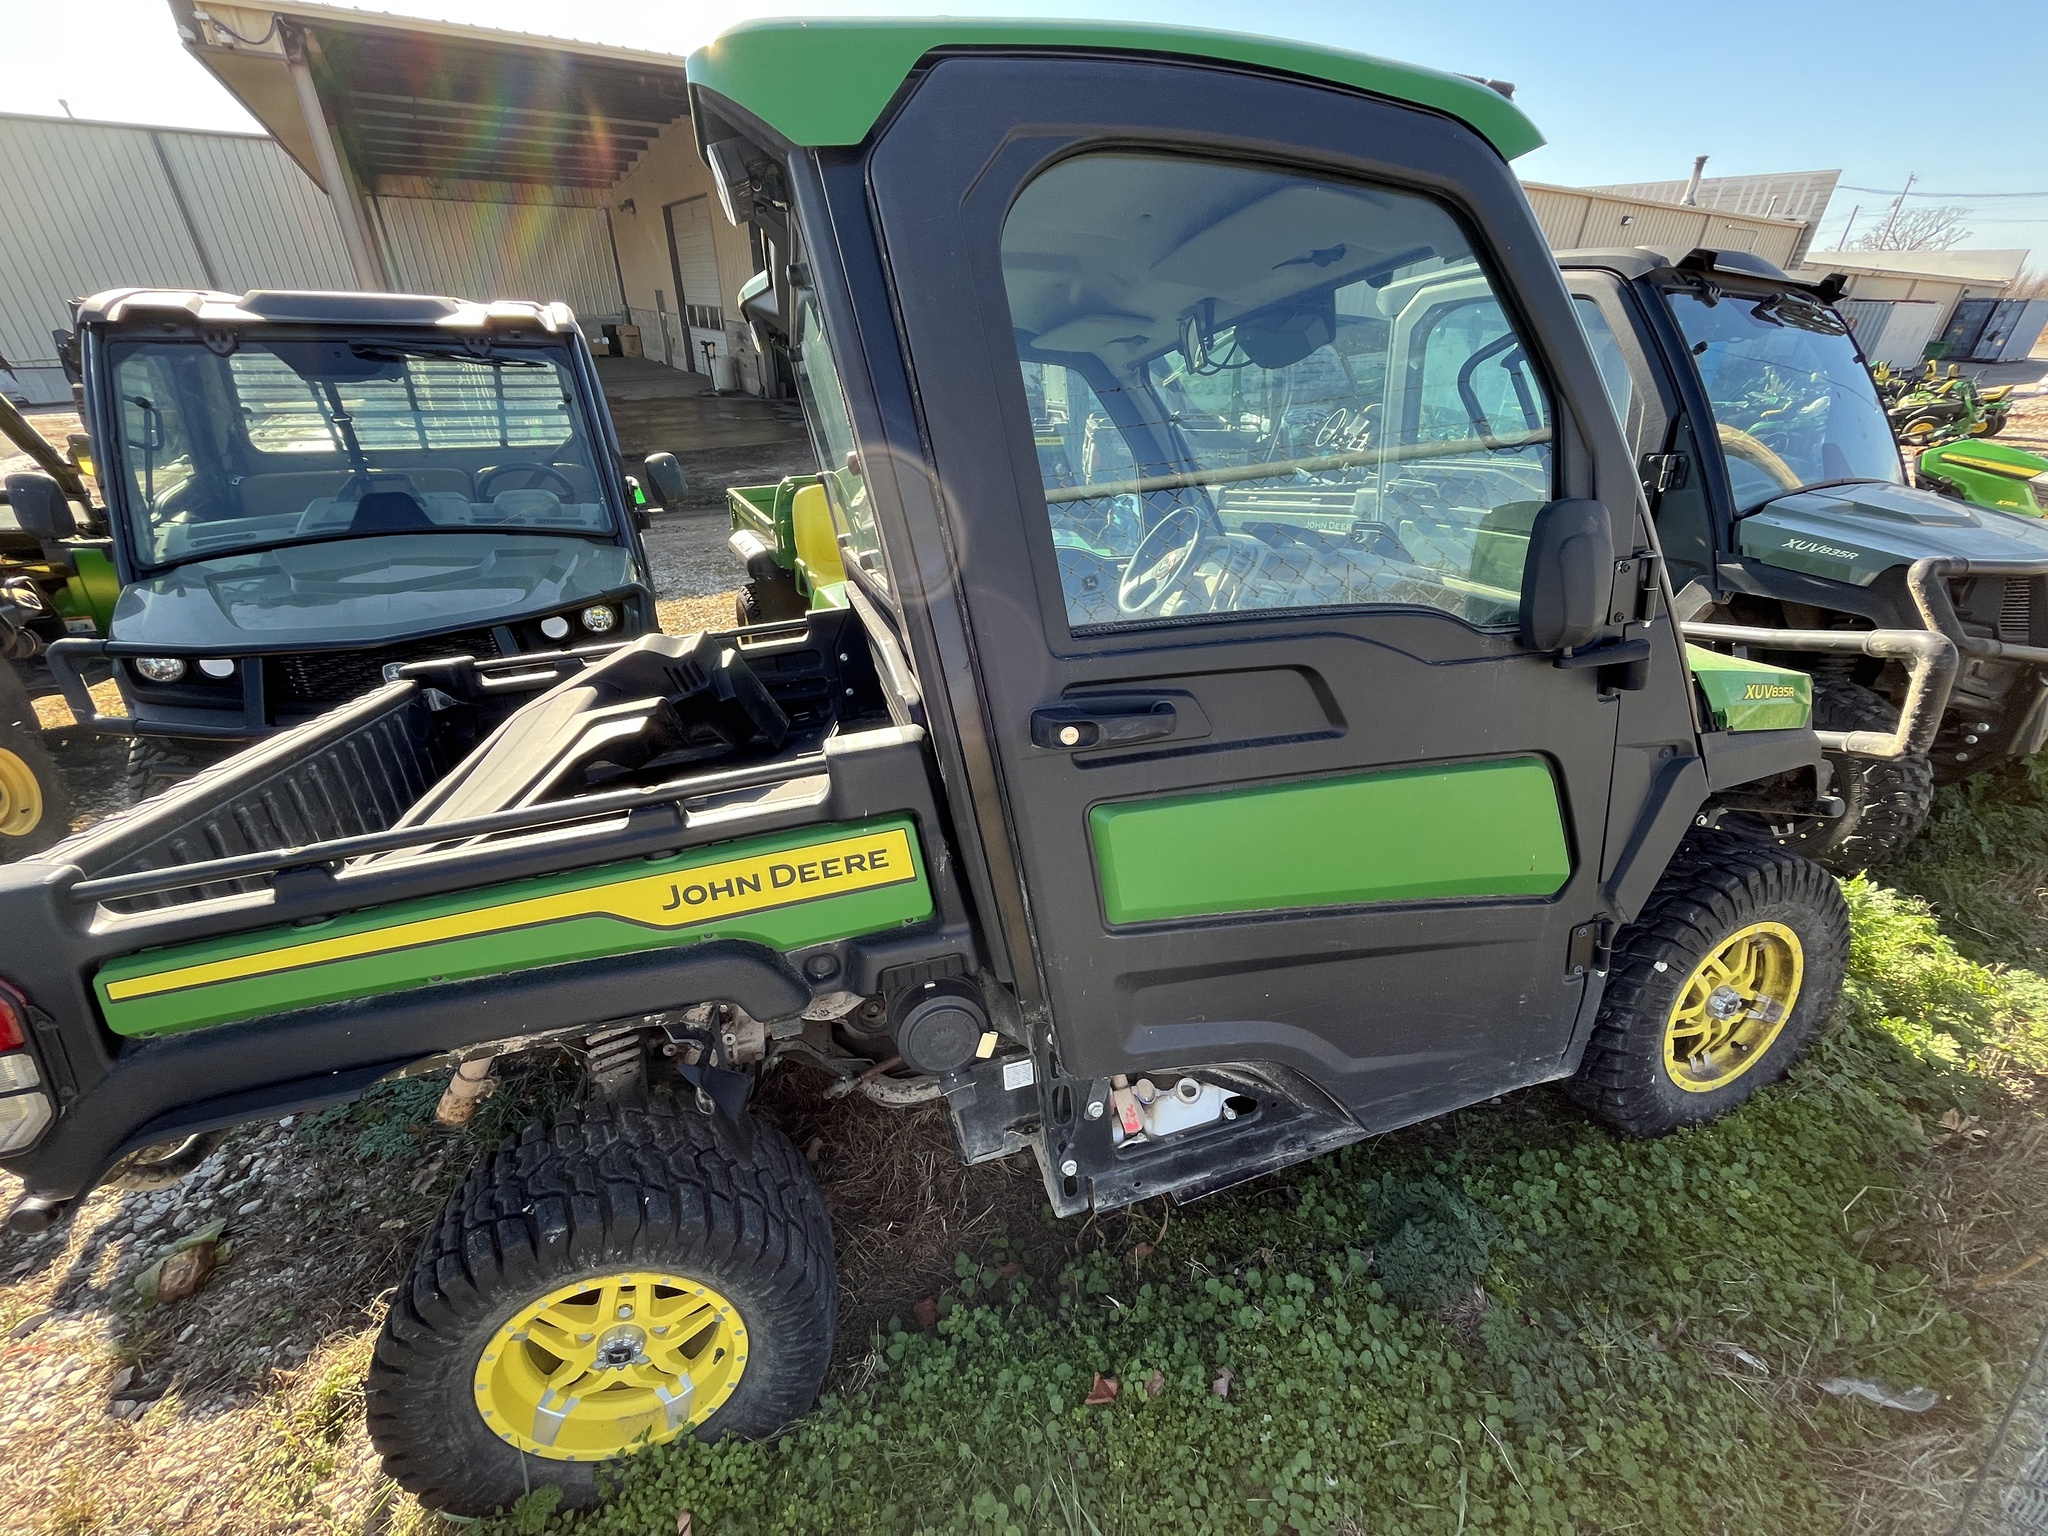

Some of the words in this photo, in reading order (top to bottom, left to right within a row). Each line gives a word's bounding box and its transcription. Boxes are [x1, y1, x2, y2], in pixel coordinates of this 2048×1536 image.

[1305, 520, 1327, 529] JOHN
[1328, 521, 1352, 531] DEER
[1781, 538, 1859, 560] XUV835R
[1744, 684, 1795, 700] XUV835R
[662, 873, 761, 911] JOHN
[769, 848, 889, 890] DEERE
